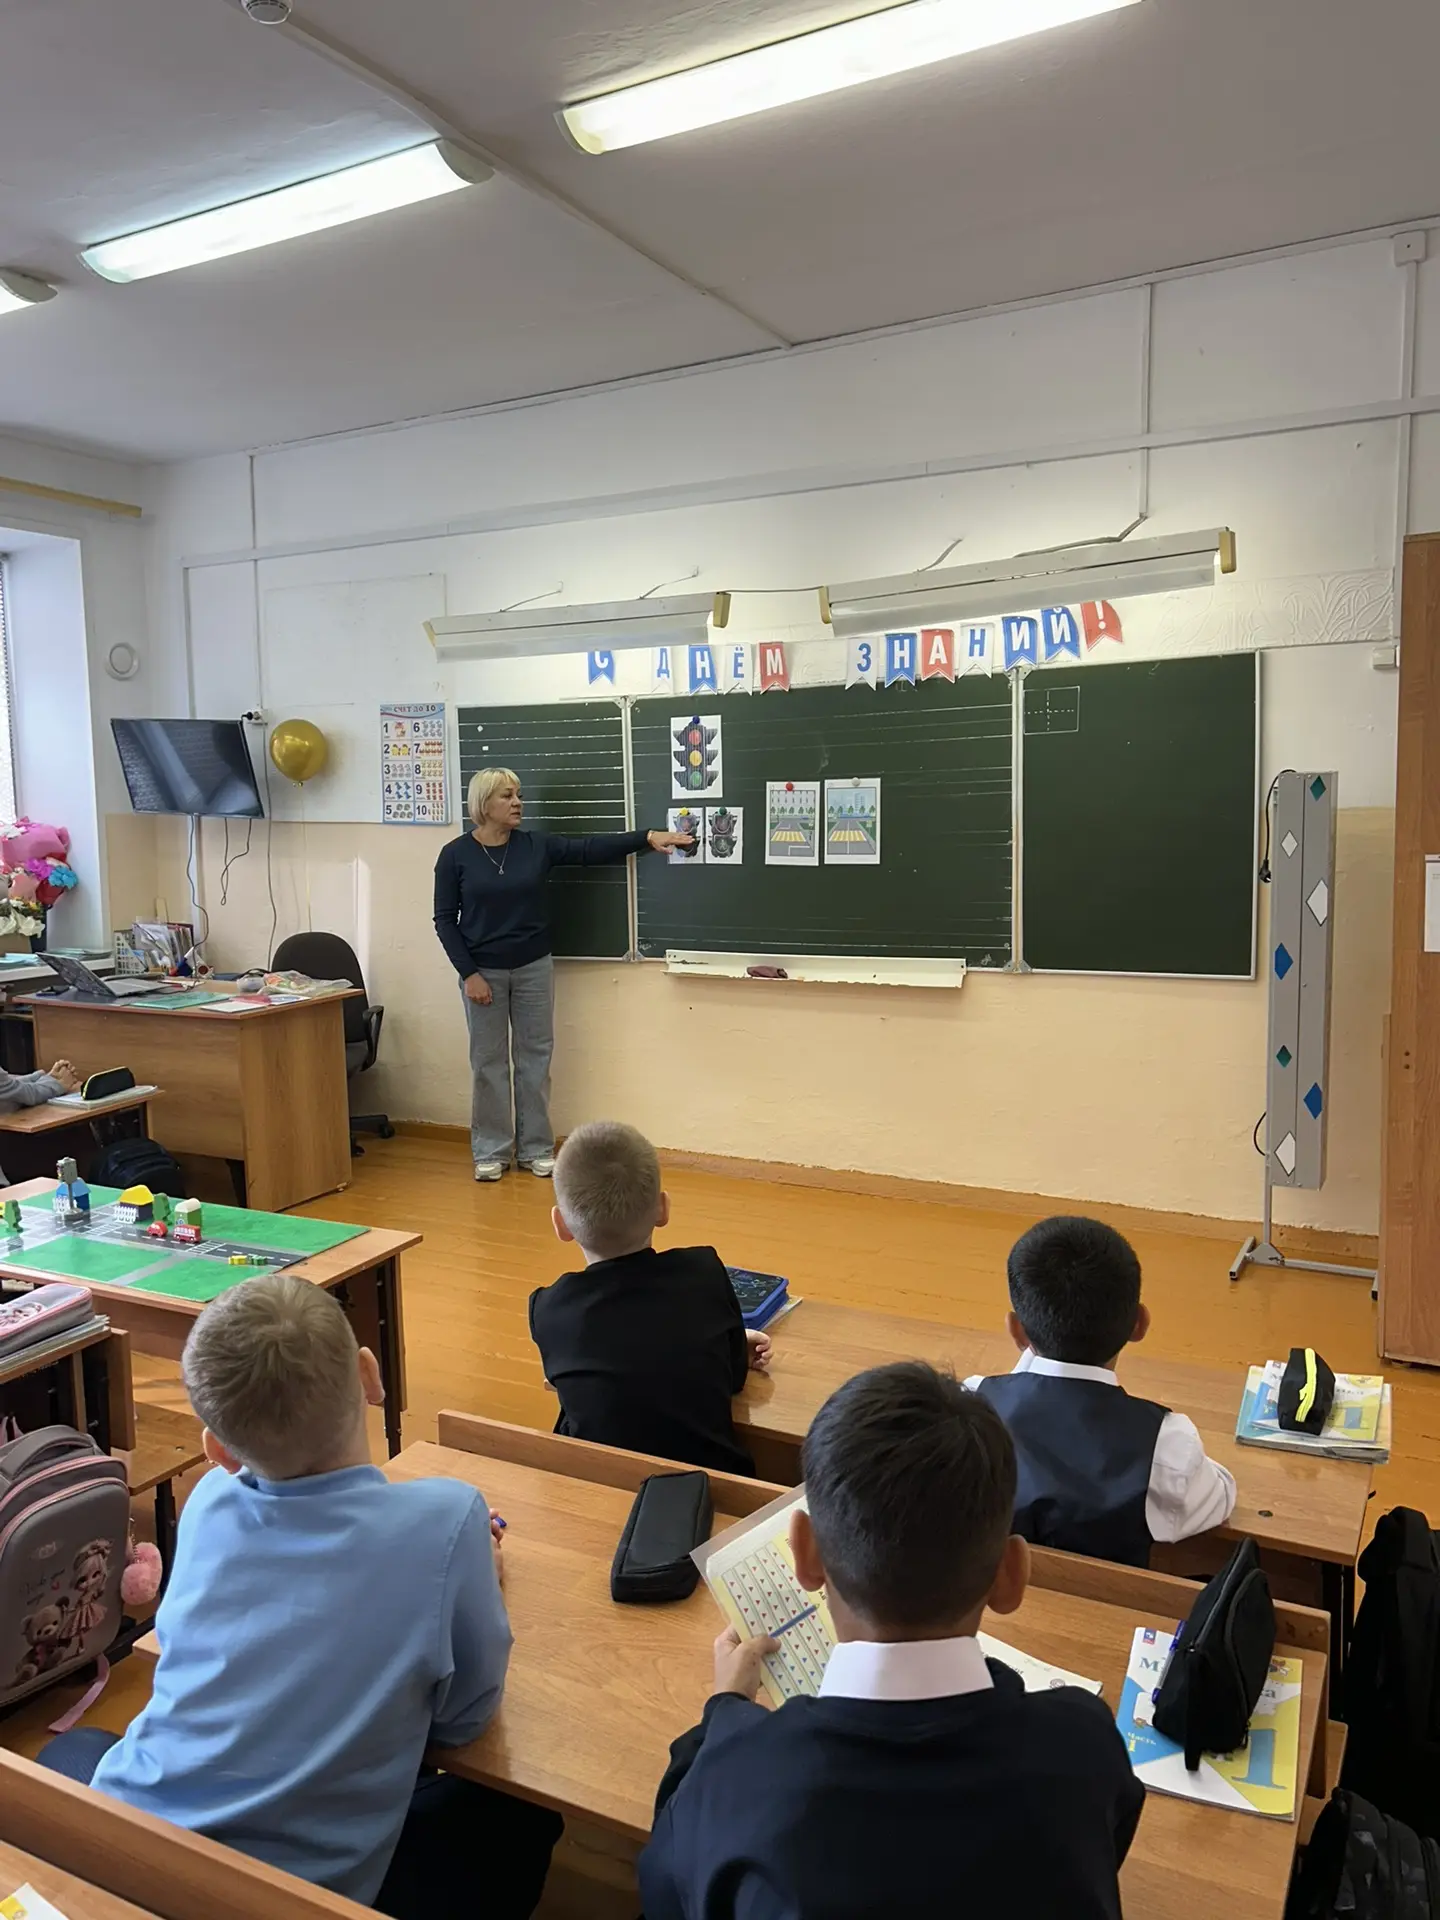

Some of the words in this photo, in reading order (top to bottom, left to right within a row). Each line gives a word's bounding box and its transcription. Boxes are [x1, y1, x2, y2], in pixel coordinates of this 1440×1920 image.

[657, 646, 784, 679] ДНЁМ
[857, 601, 1106, 673] ЗНАНИЙ!
[426, 704, 436, 712] 10
[383, 722, 389, 733] 1
[413, 722, 420, 733] 6
[383, 743, 390, 754] 2
[413, 743, 420, 753] 7
[384, 763, 390, 774] 3
[414, 763, 421, 774] 8
[385, 783, 392, 794] 4
[415, 783, 422, 794] 9
[385, 804, 392, 815] 5
[416, 804, 427, 815] 10
